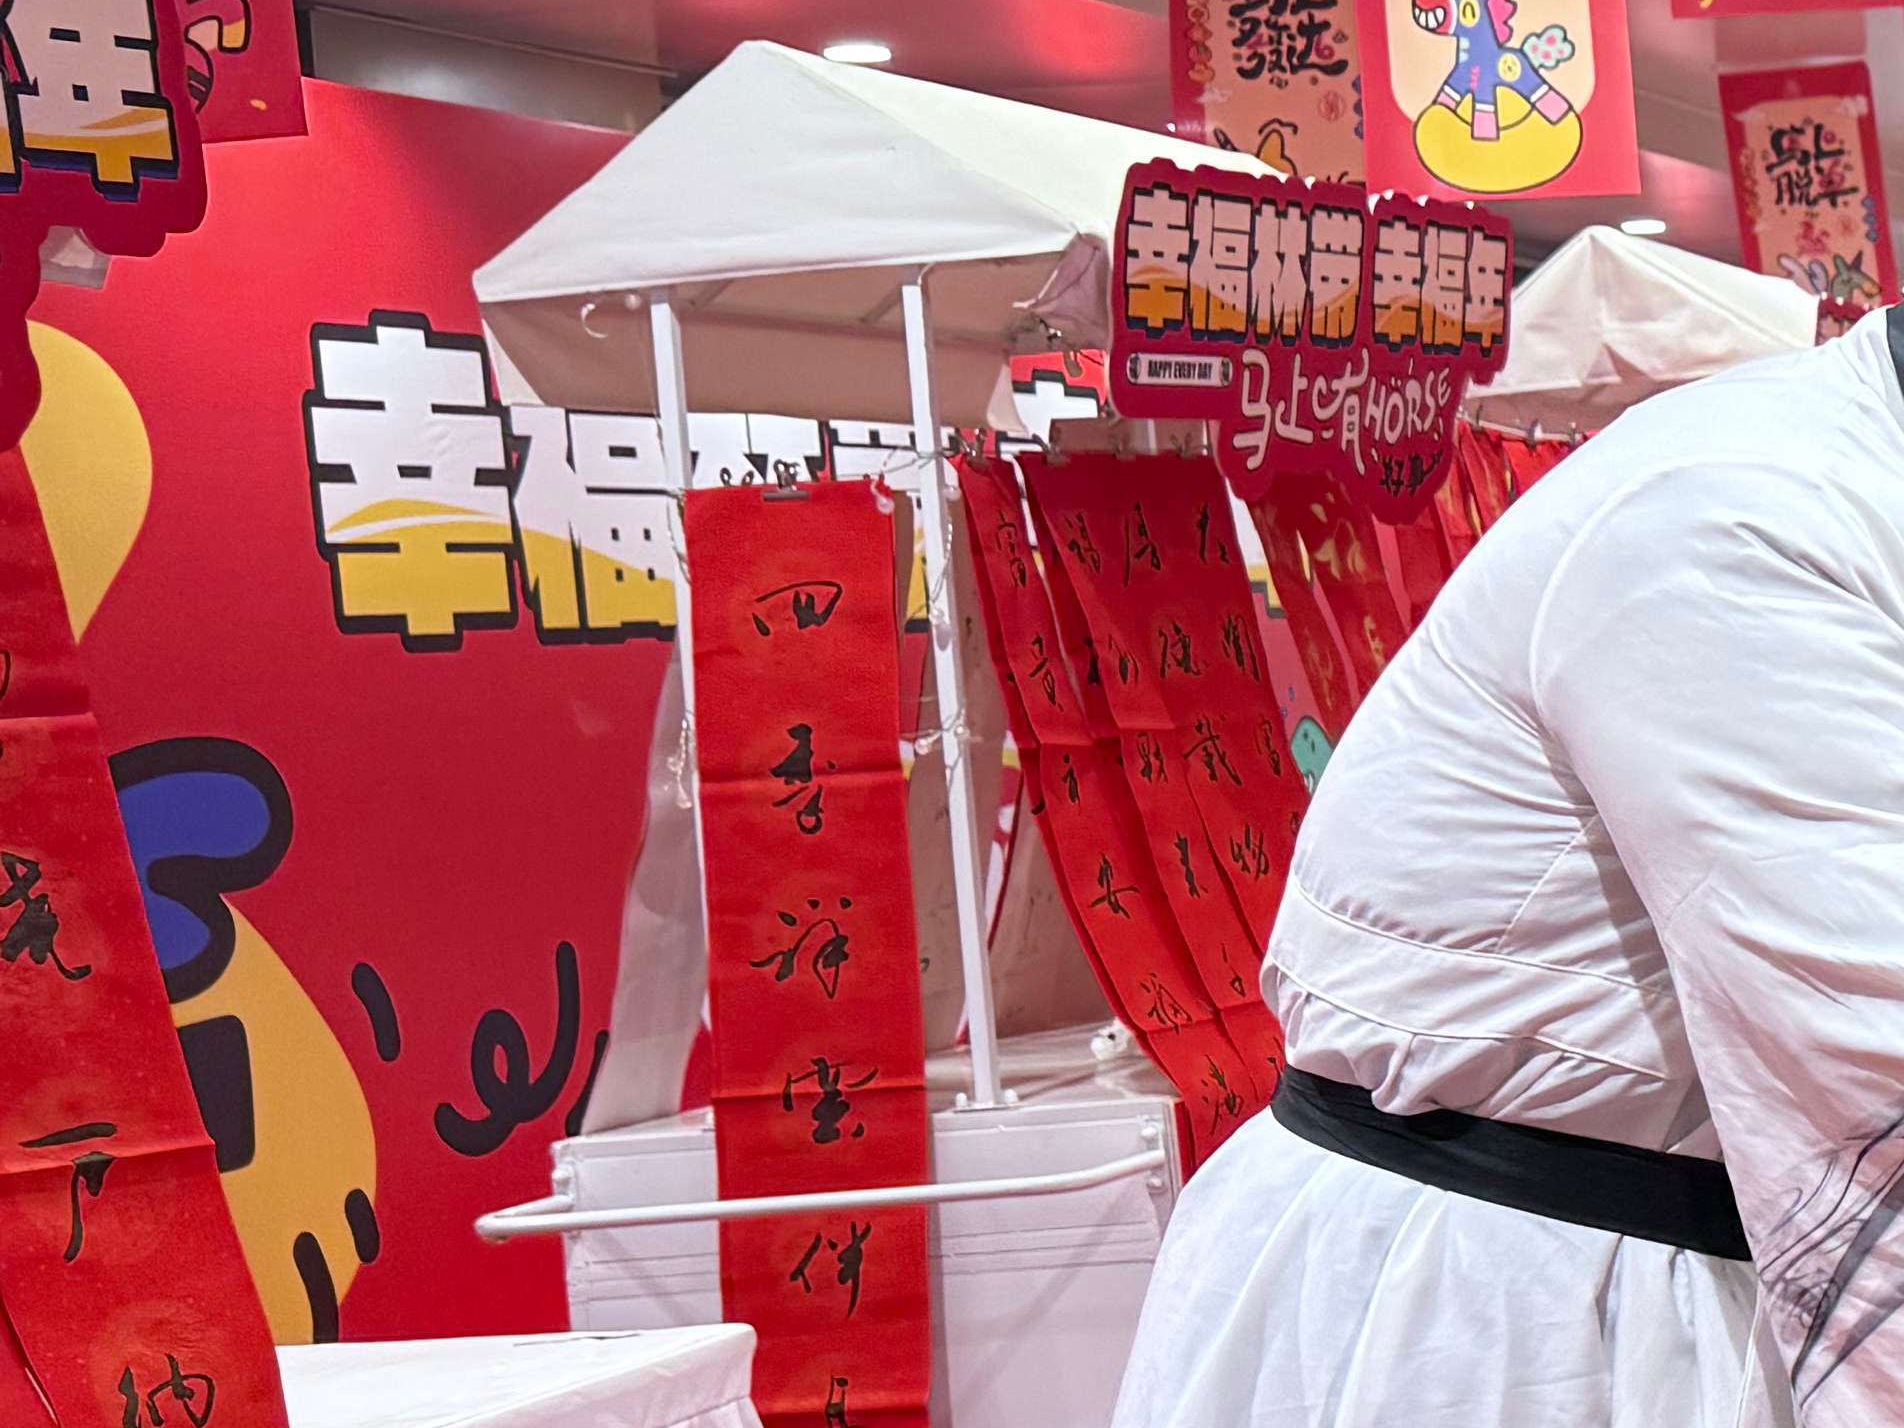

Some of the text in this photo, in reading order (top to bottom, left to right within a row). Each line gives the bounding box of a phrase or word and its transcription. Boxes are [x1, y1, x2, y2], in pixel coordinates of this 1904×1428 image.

[1126, 183, 1507, 357] 幸福林带 幸福年
